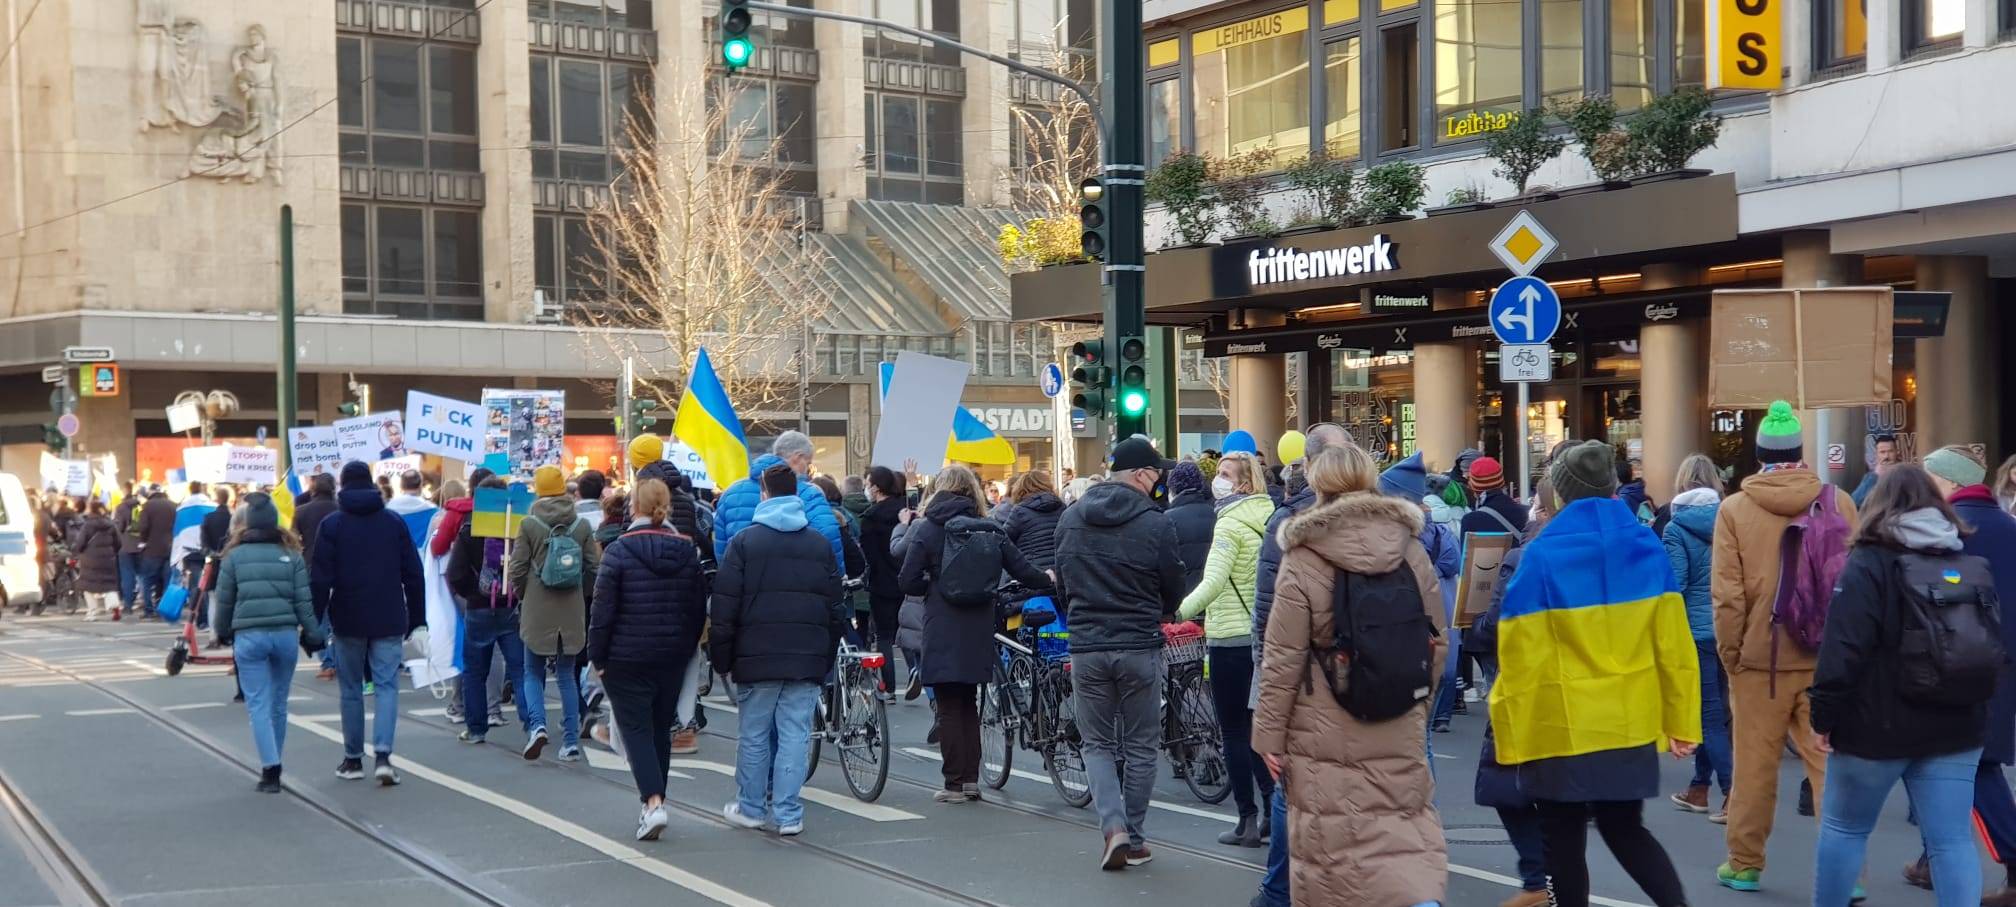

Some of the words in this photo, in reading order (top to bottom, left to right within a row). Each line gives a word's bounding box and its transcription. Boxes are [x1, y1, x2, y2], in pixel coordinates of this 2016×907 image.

[1216, 15, 1282, 47] LEIHHAUS
[1249, 234, 1393, 285] frittenwerk
[1375, 295, 1429, 307] frittenwerk
[1227, 341, 1266, 354] frittenwerk
[1518, 368, 1534, 377] frei
[417, 428, 474, 451] PUTIN
[294, 442, 317, 450] drop
[297, 455, 314, 463] not
[383, 462, 411, 470] STOP
